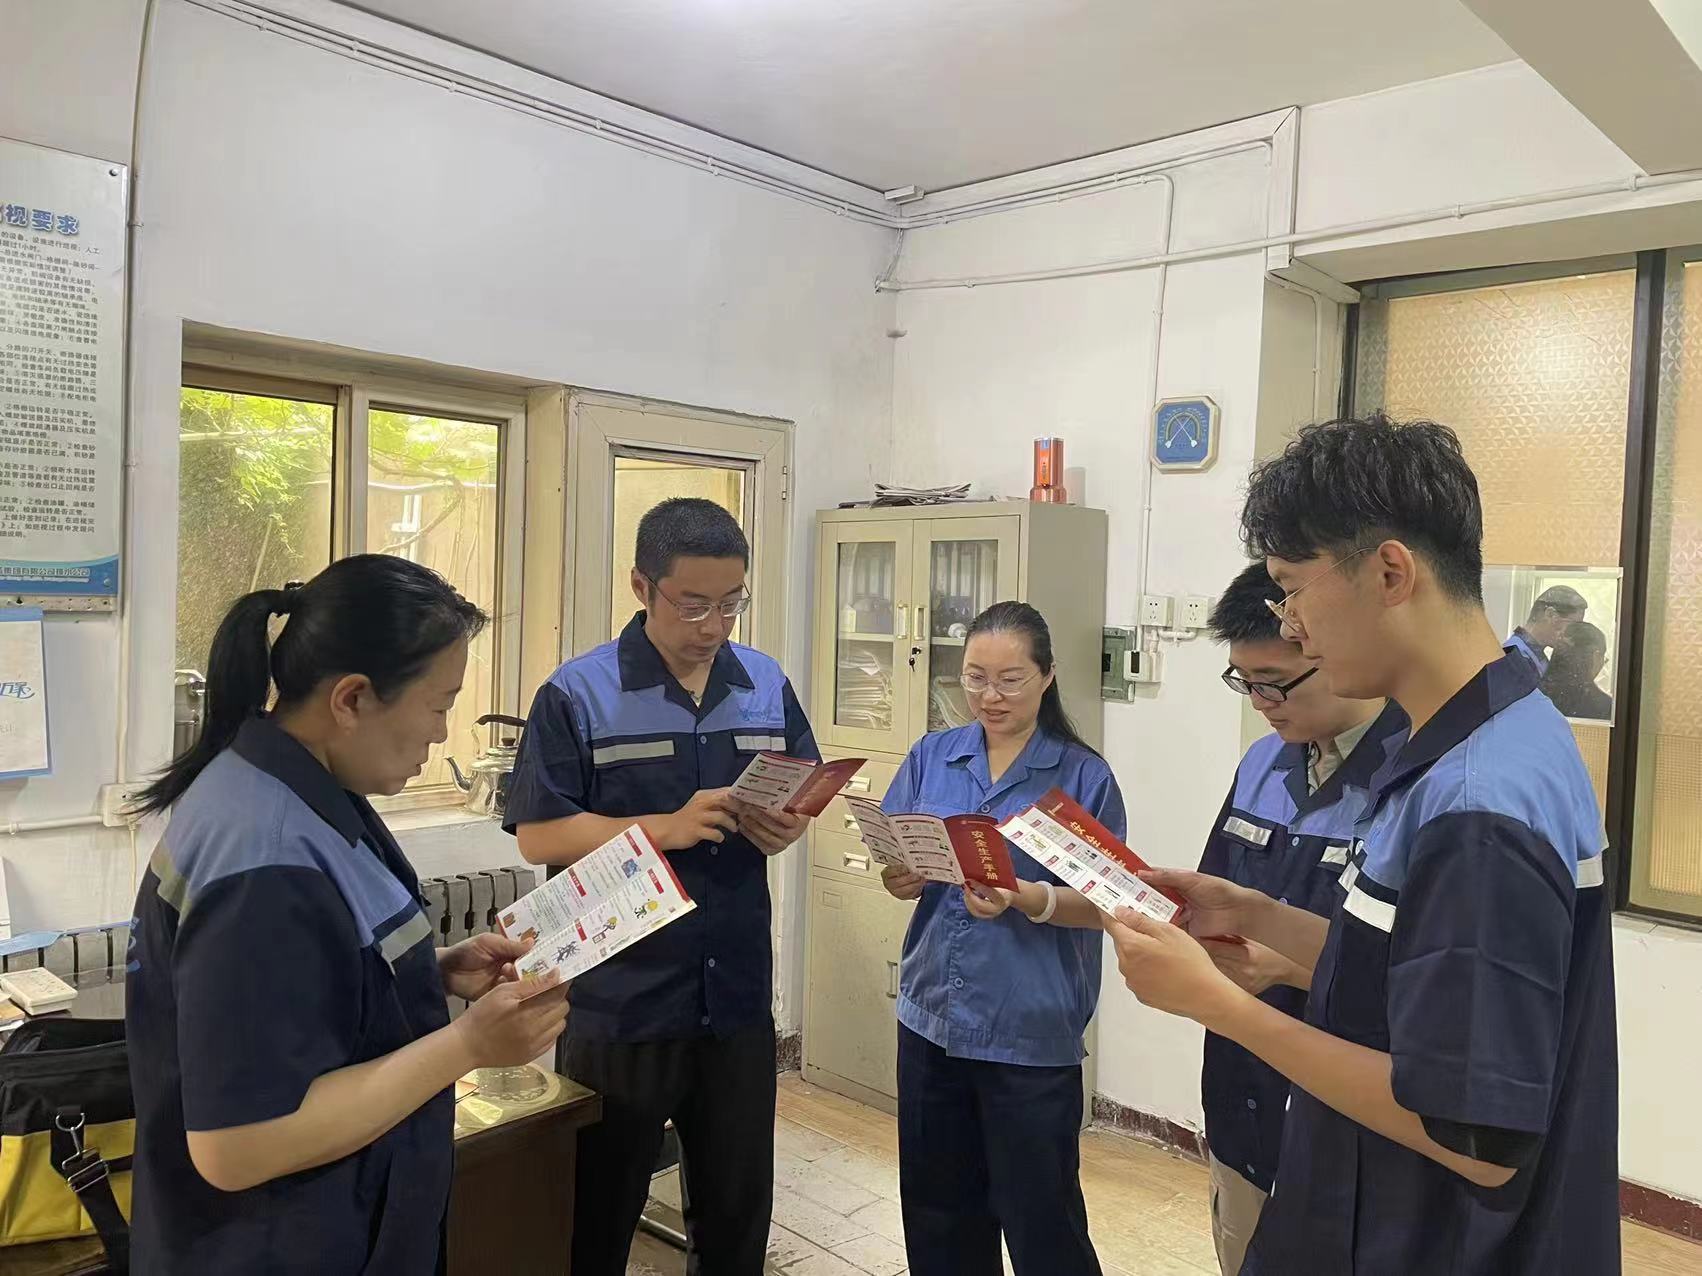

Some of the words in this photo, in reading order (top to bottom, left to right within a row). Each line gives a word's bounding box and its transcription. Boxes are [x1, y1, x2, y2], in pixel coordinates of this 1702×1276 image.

[1, 203, 79, 235] 视要求
[971, 830, 998, 880] 安全生产手册
